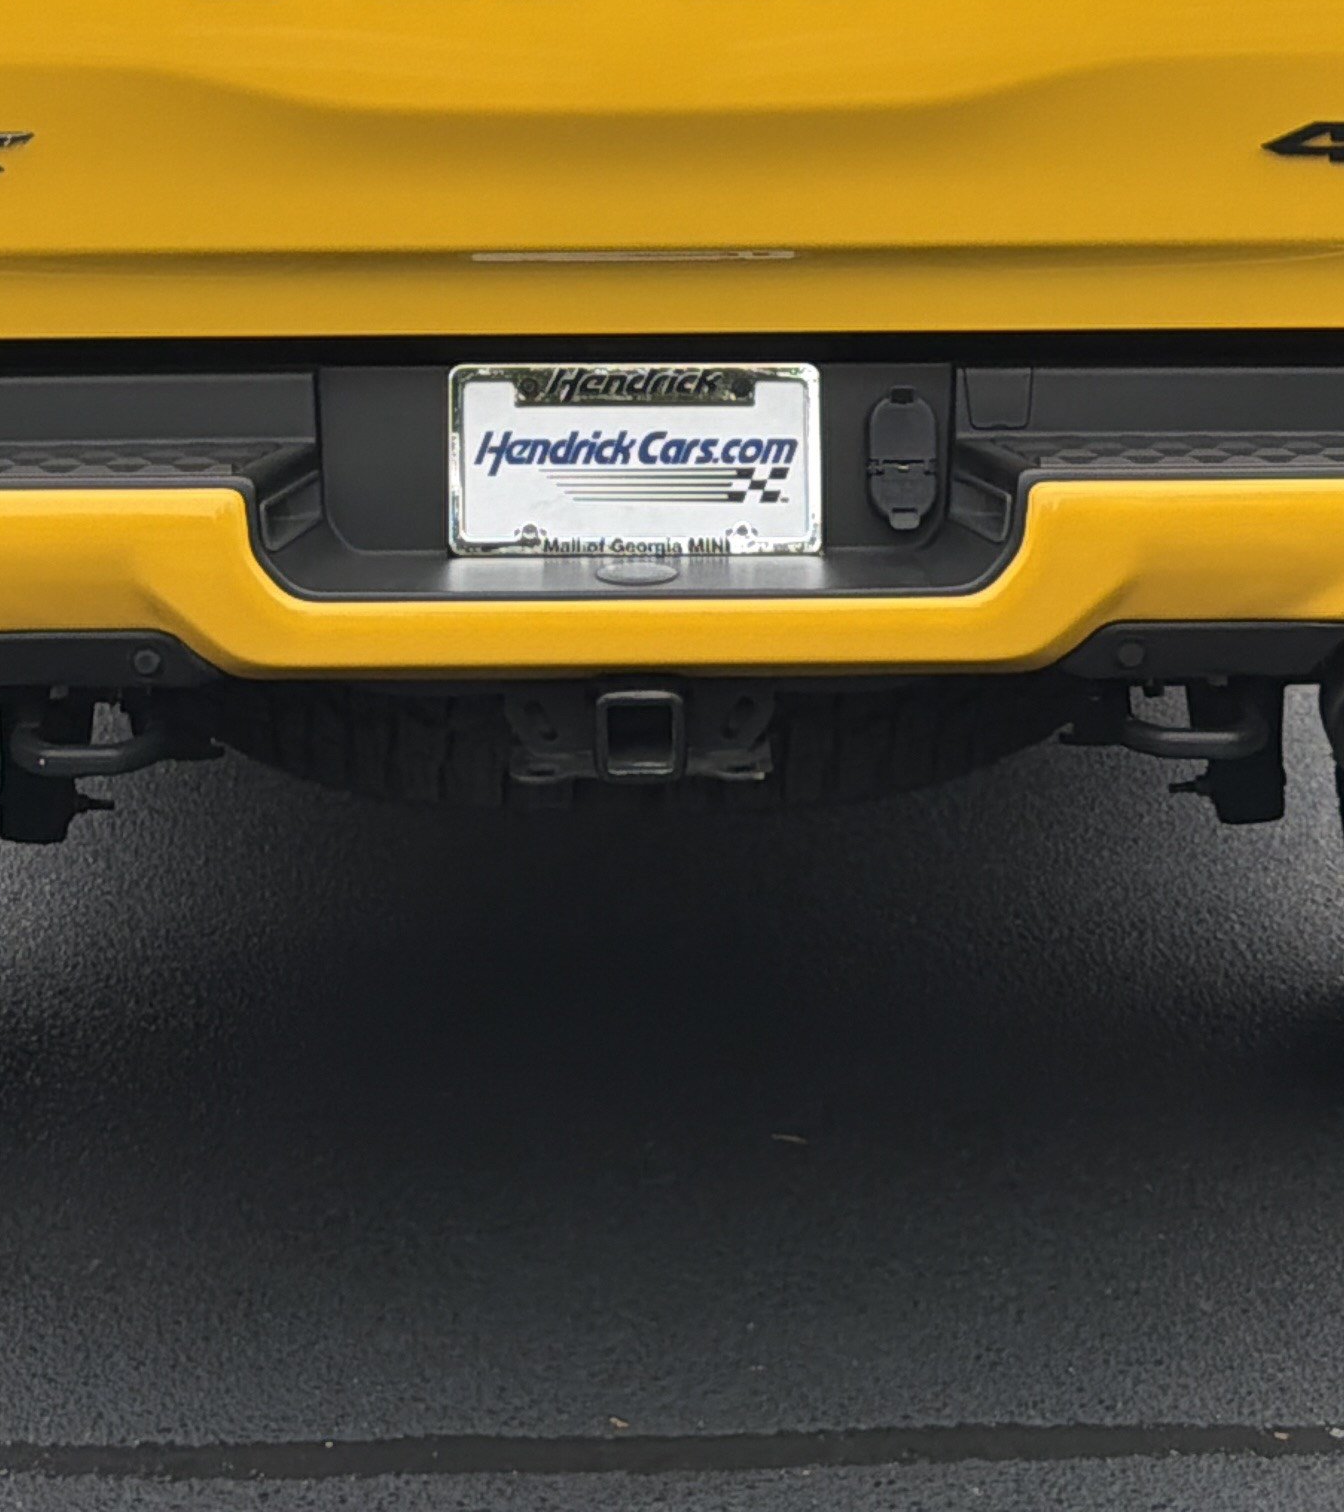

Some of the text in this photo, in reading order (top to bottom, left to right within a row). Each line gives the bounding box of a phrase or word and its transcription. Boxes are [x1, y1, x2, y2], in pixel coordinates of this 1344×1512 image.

[545, 367, 724, 403] Hendrick
[543, 537, 731, 557] Mall of Georgia MINI
